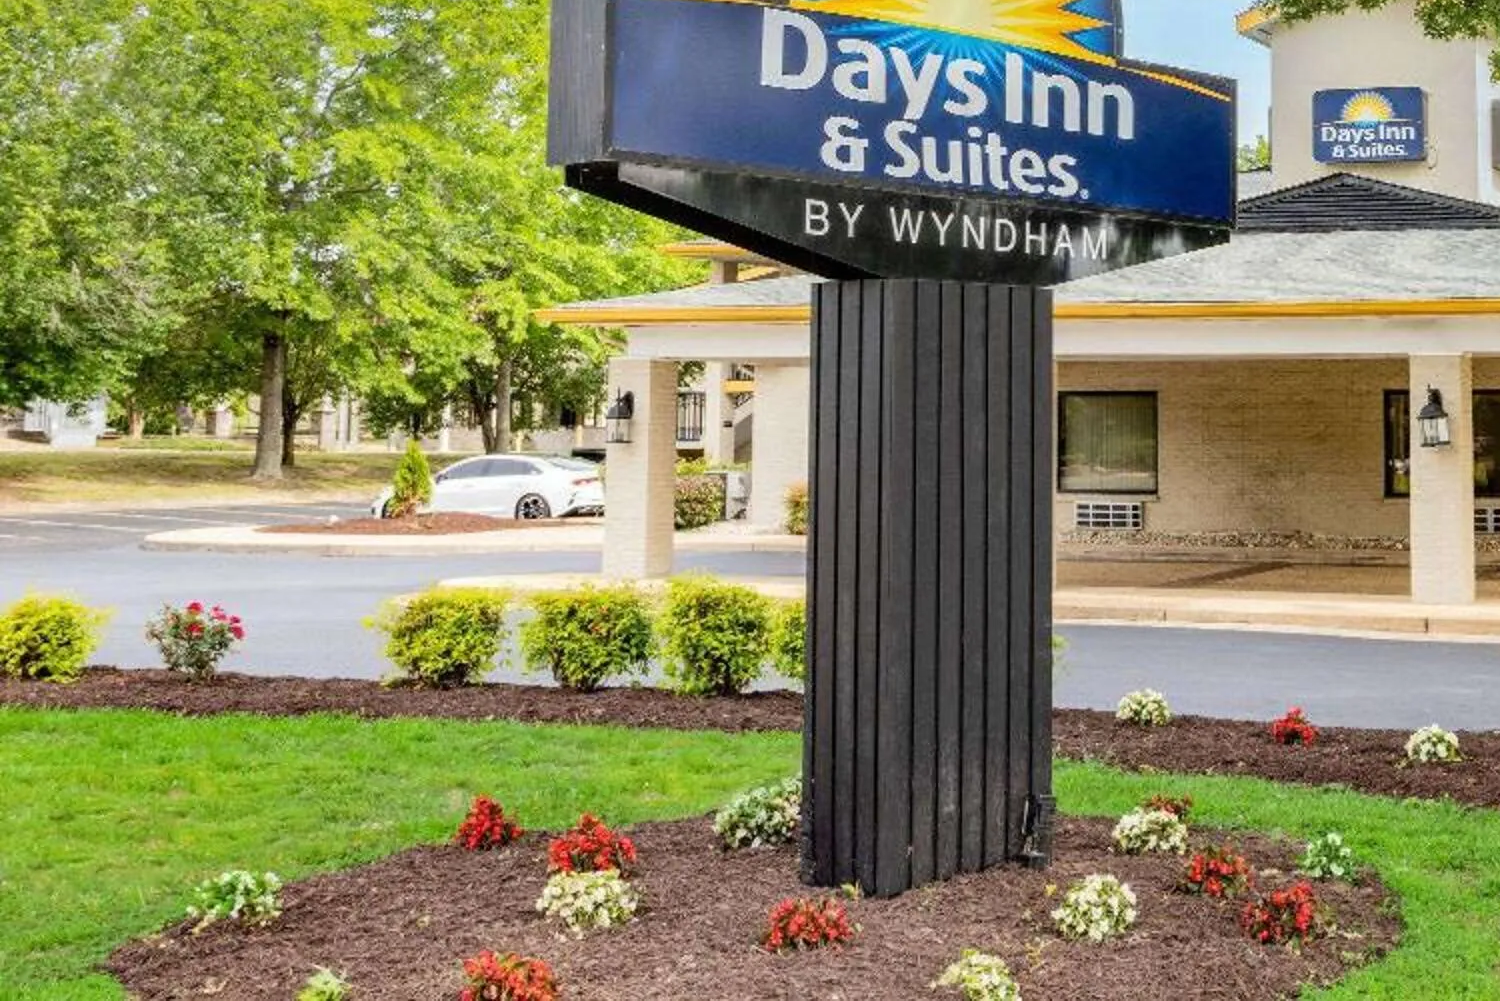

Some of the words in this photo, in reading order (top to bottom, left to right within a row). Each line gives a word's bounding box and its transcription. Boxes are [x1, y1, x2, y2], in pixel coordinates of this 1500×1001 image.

[759, 7, 986, 120] Days
[1005, 52, 1135, 140] Inn
[820, 115, 868, 172] &
[1320, 124, 1376, 143] Days
[1379, 124, 1416, 140] Inn
[1331, 145, 1343, 158] &
[804, 199, 865, 239] BY
[891, 209, 1109, 261] WYNDHAM
